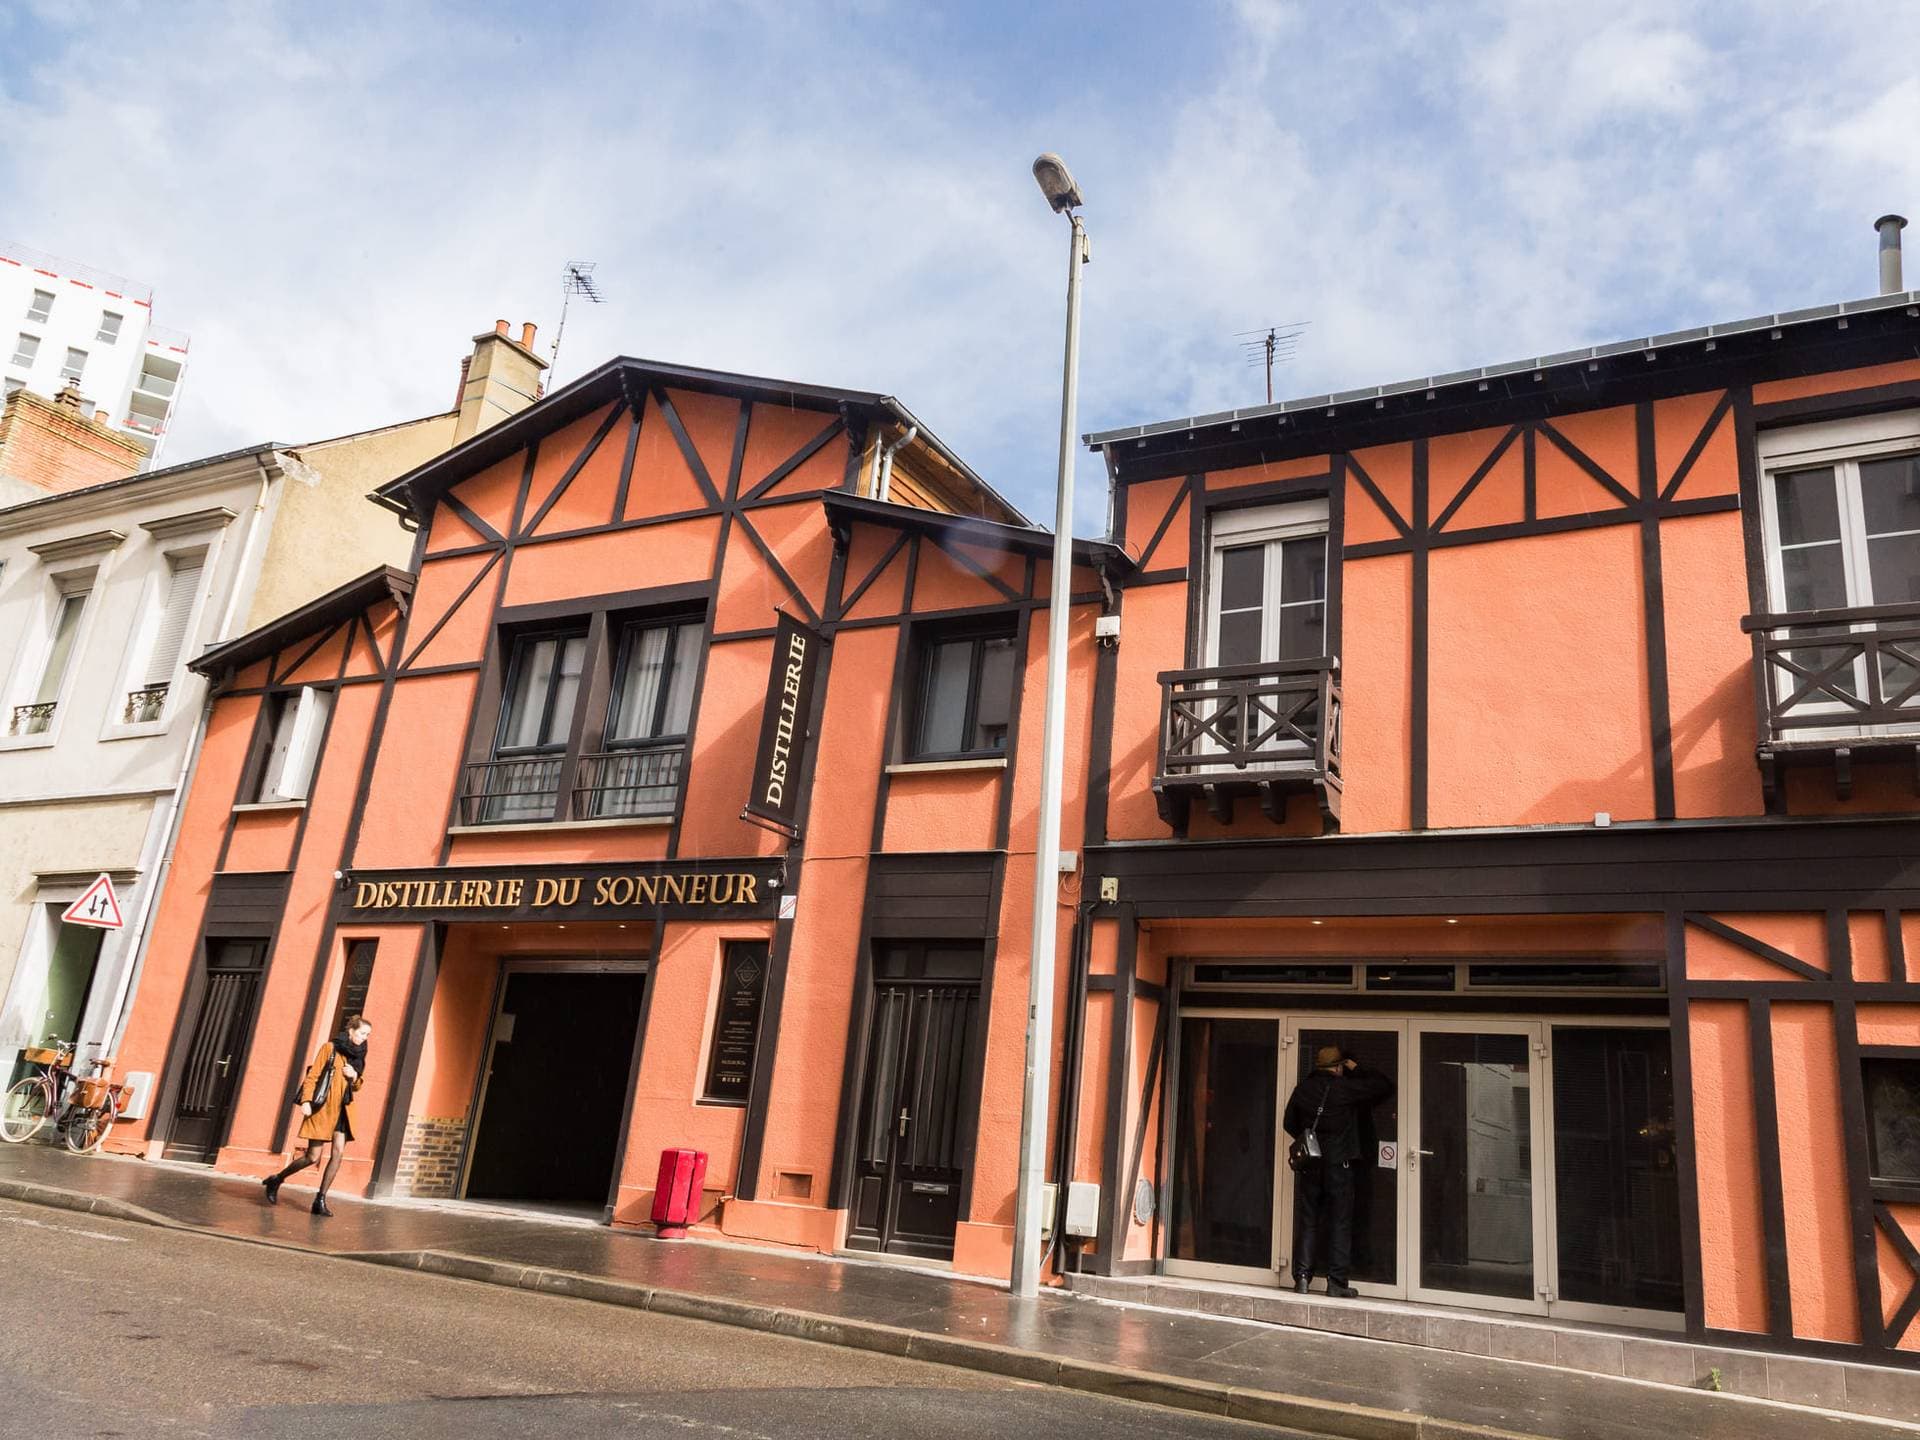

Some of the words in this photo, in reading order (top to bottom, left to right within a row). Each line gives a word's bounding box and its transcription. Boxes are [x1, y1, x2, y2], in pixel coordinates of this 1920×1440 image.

[766, 633, 806, 808] DISTILLERIE
[353, 879, 524, 908] DISTILLERIE
[531, 878, 584, 907] DU
[593, 873, 758, 906] SONNEUR
